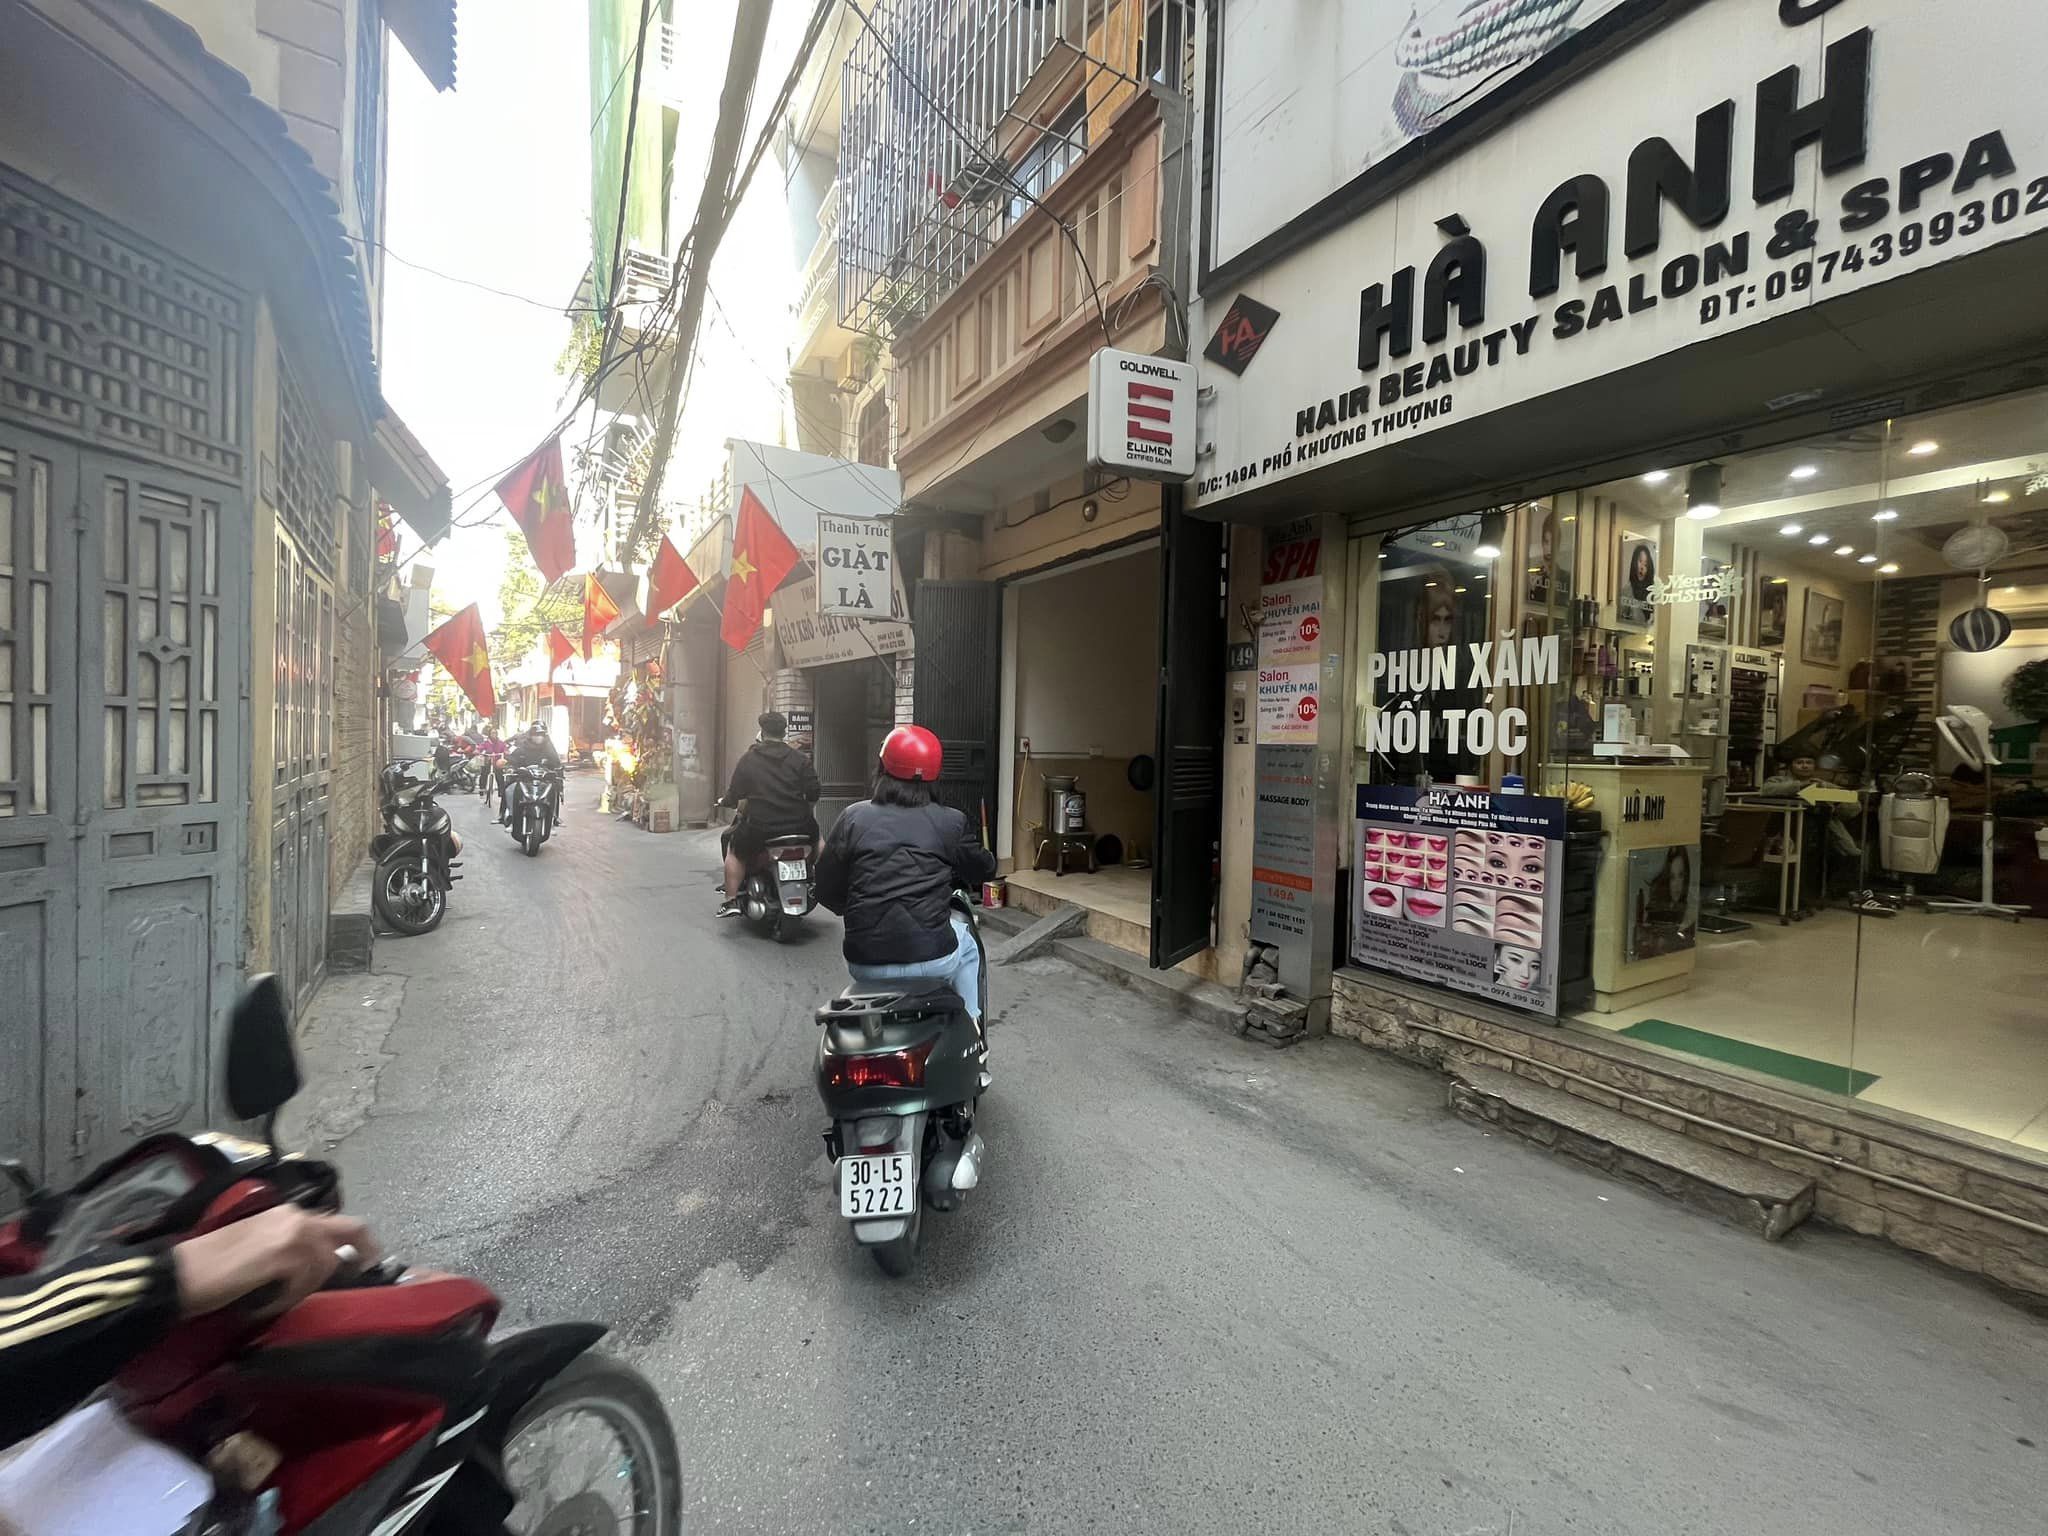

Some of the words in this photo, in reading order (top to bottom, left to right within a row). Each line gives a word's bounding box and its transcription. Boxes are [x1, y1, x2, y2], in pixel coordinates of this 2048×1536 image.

[1358, 213, 1487, 371] HÀ
[1529, 26, 1873, 298] ANH
[1765, 175, 2048, 301] 0974399302
[1296, 385, 1371, 437] HAIR
[1379, 315, 1540, 407] BEAUTY
[1552, 231, 1749, 340] SALON
[1766, 208, 1819, 260] &
[1840, 129, 2016, 232] SPA
[1120, 360, 1179, 380] GOLDWELL
[1127, 441, 1172, 458] ELUMEN
[1225, 462, 1257, 488] 149A
[1262, 442, 1292, 474] PHỐ
[1297, 424, 1366, 462] KHƯƠNG
[1372, 394, 1453, 437] THƯỢNG
[822, 520, 860, 535] Thanh
[863, 523, 889, 538] Trúc
[822, 542, 889, 576] GIẶT
[1264, 539, 1320, 584] SPA
[1666, 573, 1724, 590] Merry
[837, 582, 874, 609] LÀ
[1262, 594, 1291, 607] Salon
[1302, 601, 1320, 613] MẠI
[1301, 624, 1320, 636] 10%
[1231, 647, 1253, 666] 149
[1368, 645, 1456, 694] PHUN
[1467, 628, 1560, 689] XĂM
[1259, 670, 1289, 682] Salon
[1259, 680, 1297, 695] KHUYẾN
[1299, 682, 1318, 694] MẠI
[1299, 703, 1317, 715] 10%
[1365, 693, 1431, 754] NỐI
[1442, 693, 1528, 757] TÓC
[1291, 797, 1310, 807] BODY
[1455, 794, 1490, 810] ANH
[1267, 887, 1296, 902] 149A
[851, 1158, 903, 1185] 30-L5
[850, 1186, 904, 1214] 5222
